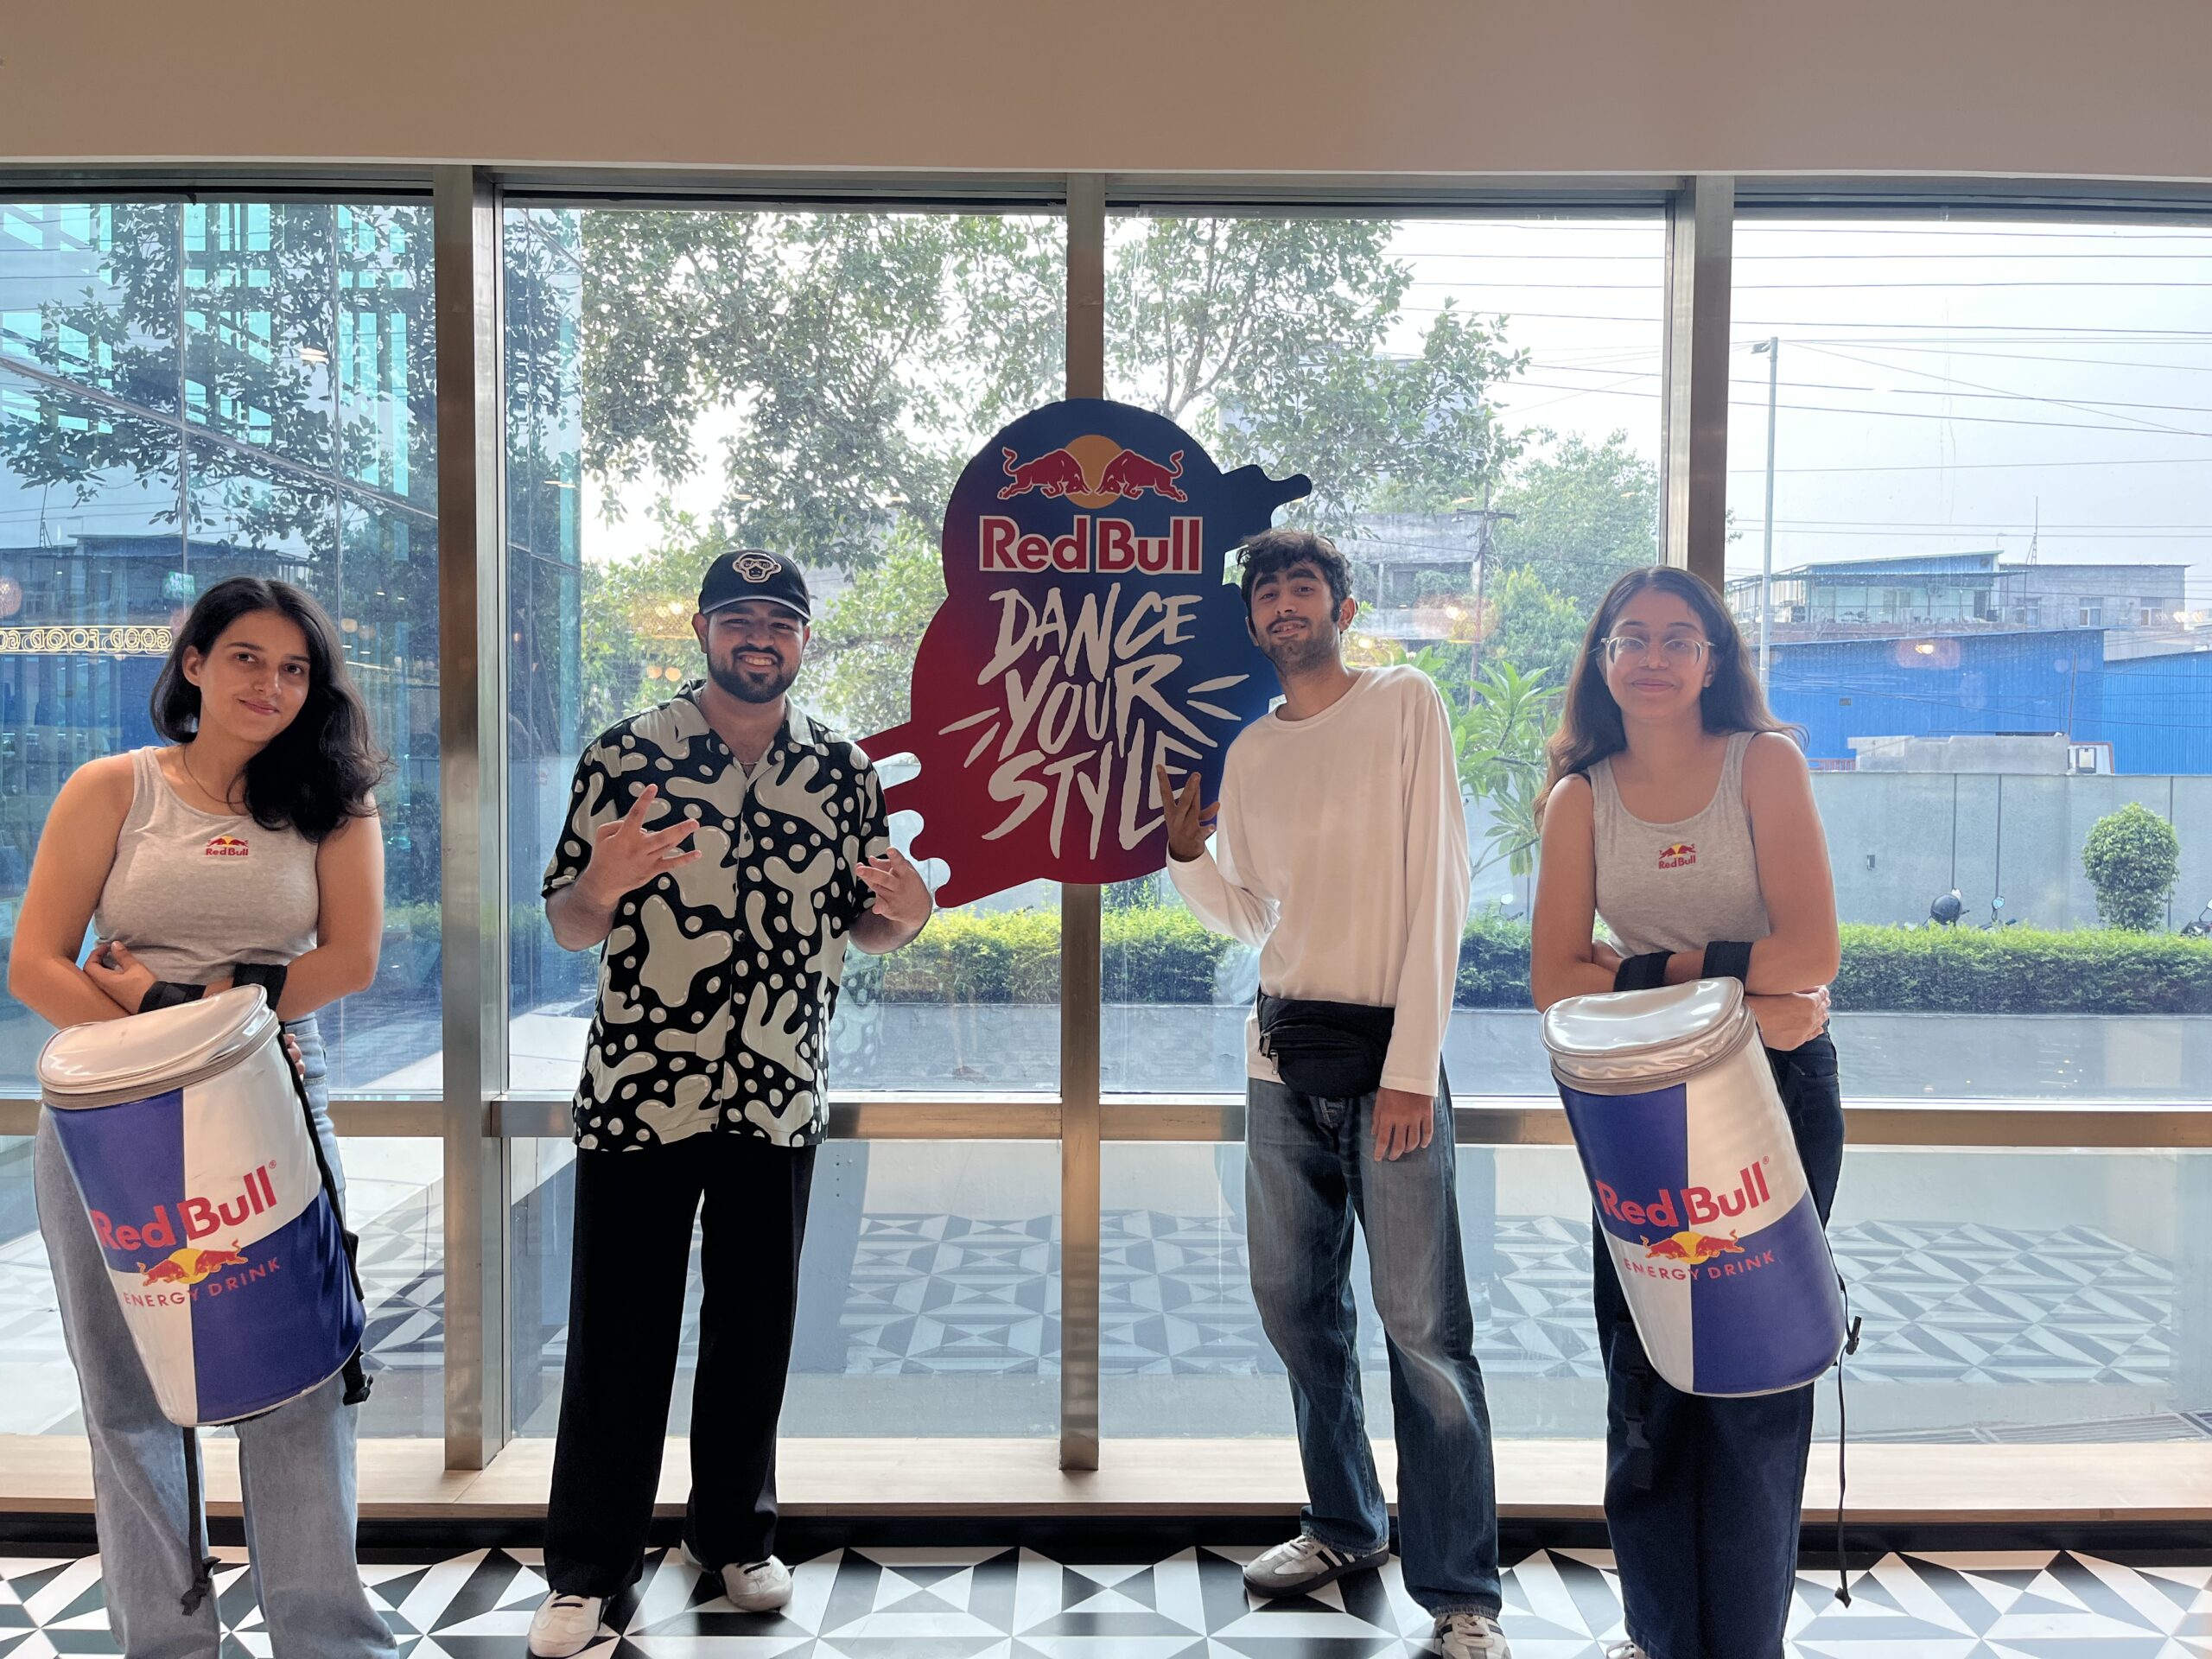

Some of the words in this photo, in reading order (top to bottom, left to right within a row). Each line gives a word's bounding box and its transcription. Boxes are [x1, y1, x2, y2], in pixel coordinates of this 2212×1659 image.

[980, 516, 1090, 572] Red
[1096, 517, 1202, 574] Bull
[977, 582, 1203, 685] DANCE
[998, 654, 1217, 761] YOUR
[982, 718, 1203, 860] STYLE
[205, 847, 226, 856] Red
[227, 847, 249, 856] Bull
[1658, 858, 1677, 869] Red
[1678, 855, 1696, 867] Bull
[90, 1205, 176, 1250] Red
[1595, 1179, 1679, 1227] Red
[123, 1289, 199, 1307] ENERGY
[207, 1257, 281, 1297] DRINK
[1623, 1258, 1699, 1281] ENERGY
[1707, 1250, 1776, 1280] DRINK
